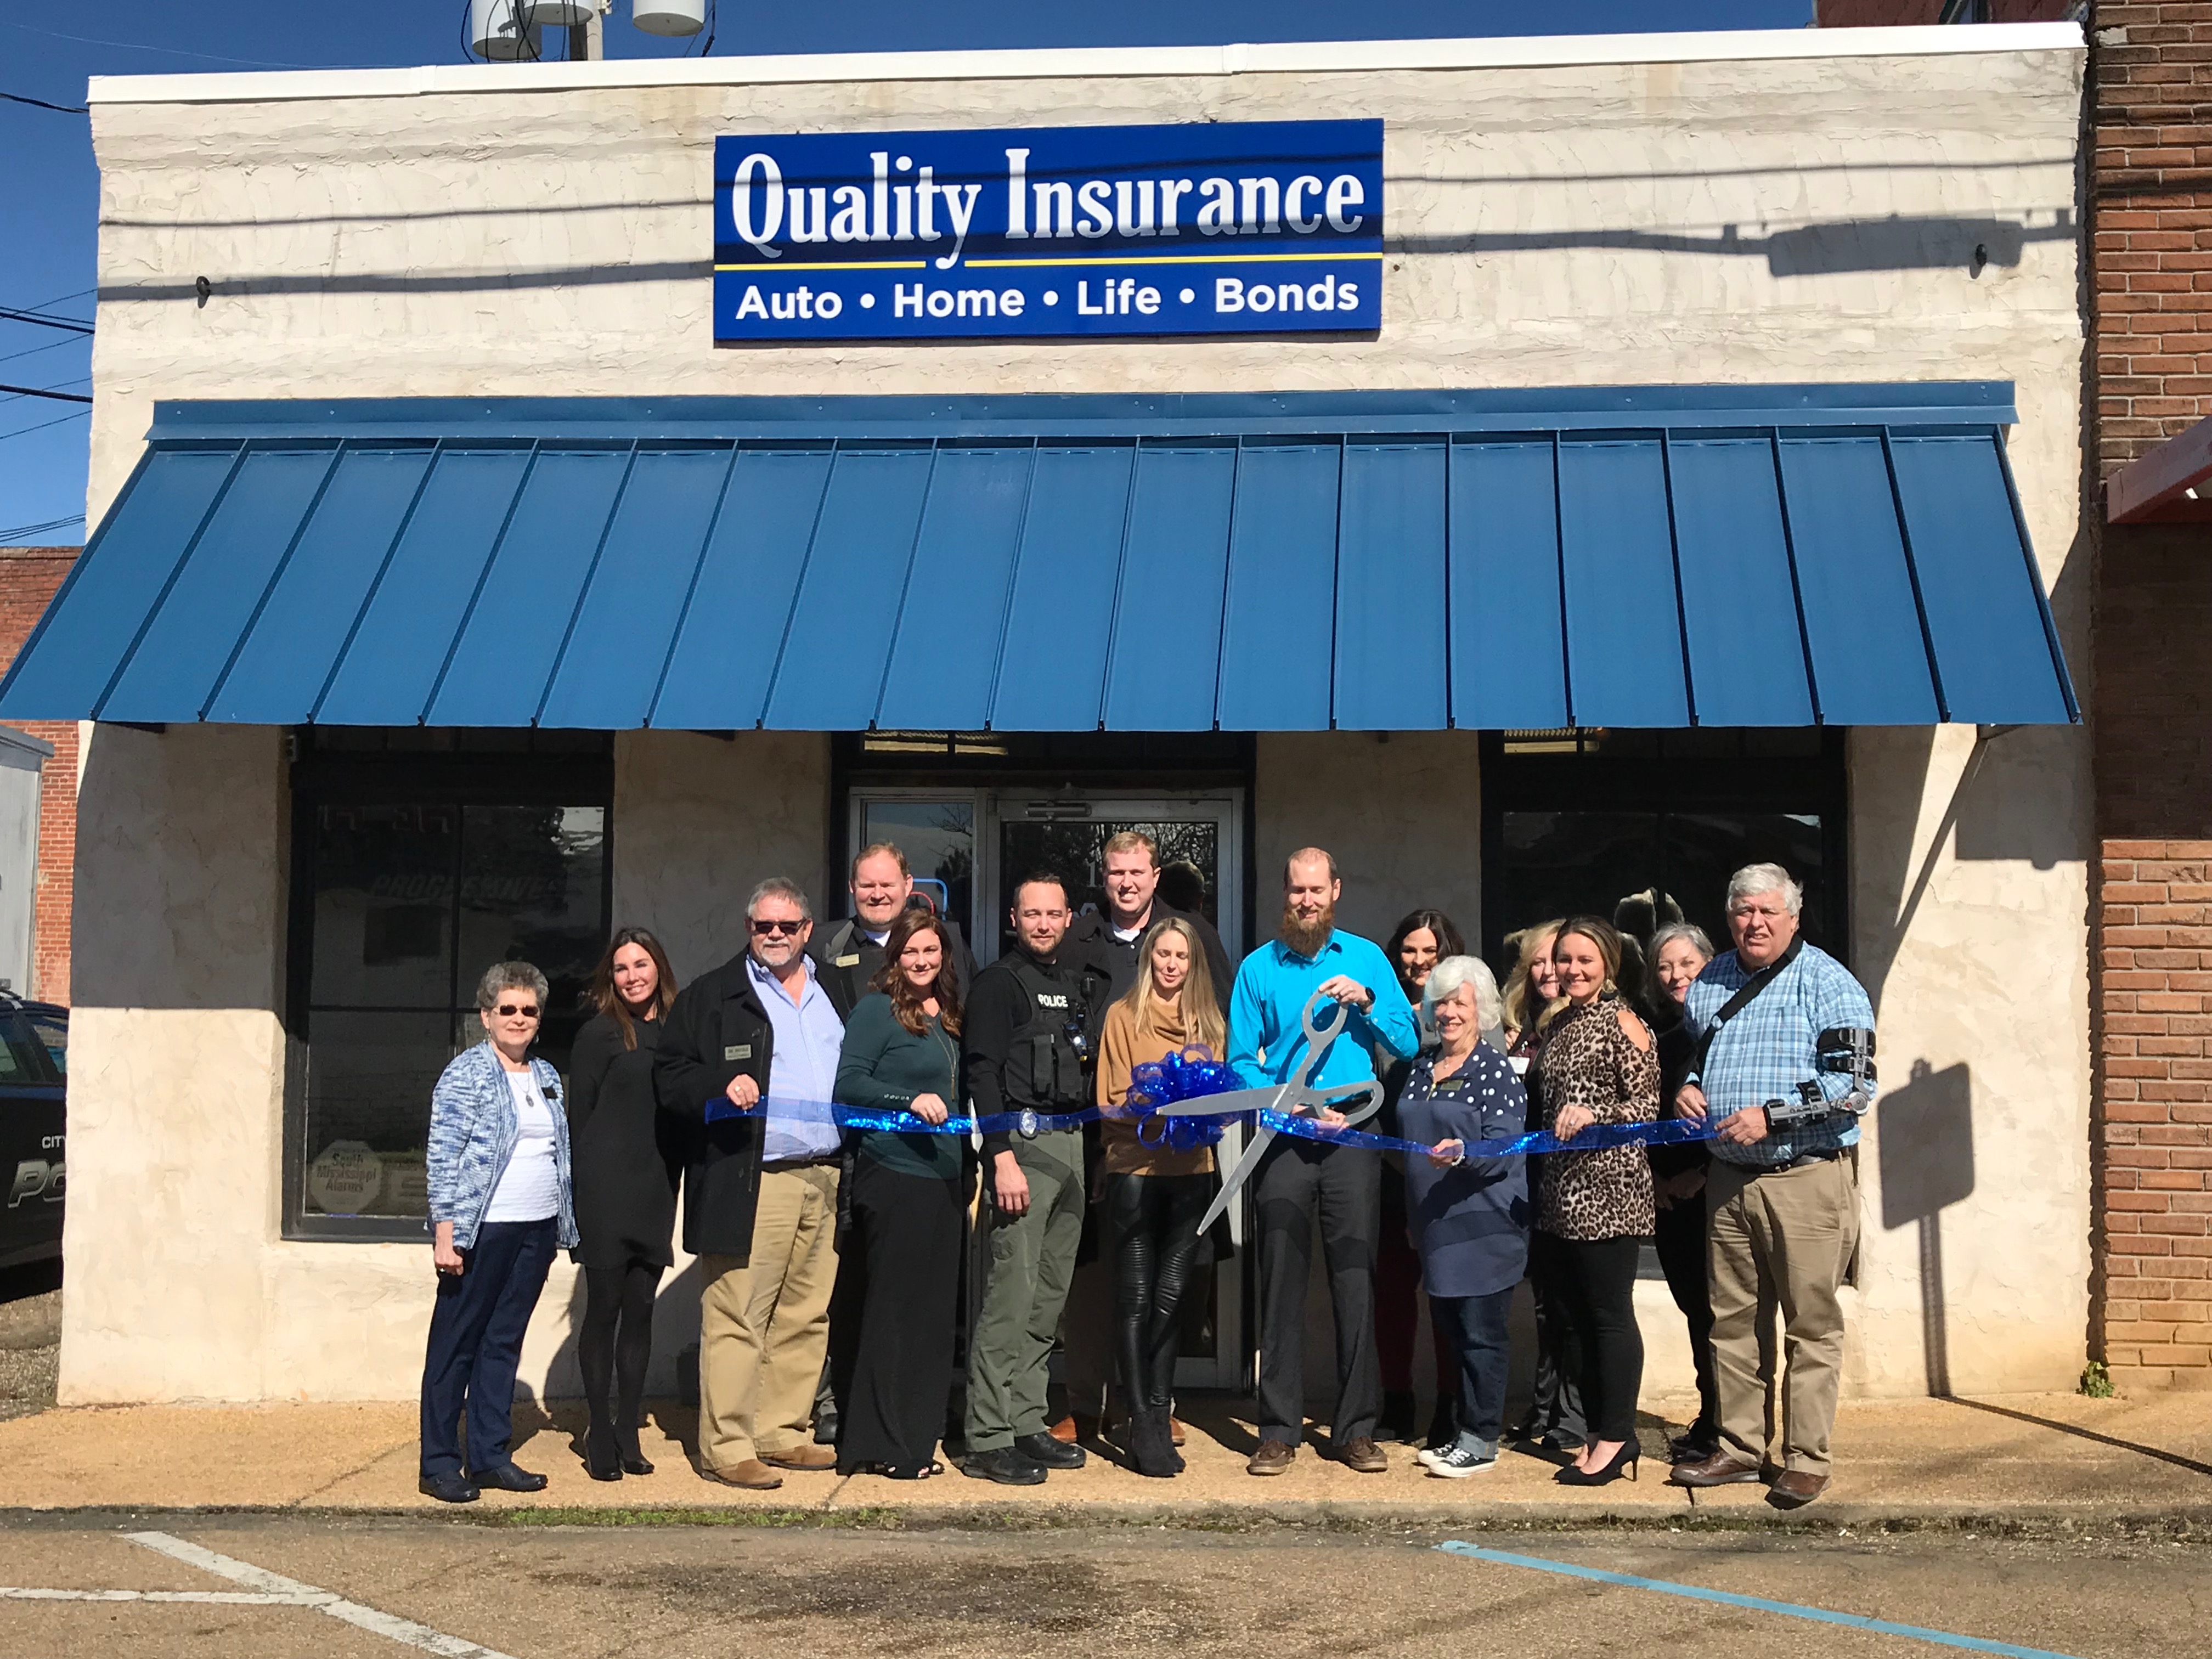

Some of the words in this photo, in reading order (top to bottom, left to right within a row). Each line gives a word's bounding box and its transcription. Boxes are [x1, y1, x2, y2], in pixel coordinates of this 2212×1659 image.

[731, 151, 982, 269] Quality
[1005, 148, 1364, 239] Insurance
[736, 285, 843, 319] Auto
[894, 283, 1025, 318] Home
[1078, 278, 1161, 315] Life
[1215, 274, 1359, 313] Bonds
[1037, 994, 1069, 1007] POLICE
[332, 1152, 364, 1167] South
[317, 1165, 376, 1182] Mississippi
[326, 1178, 364, 1192] Alarms
